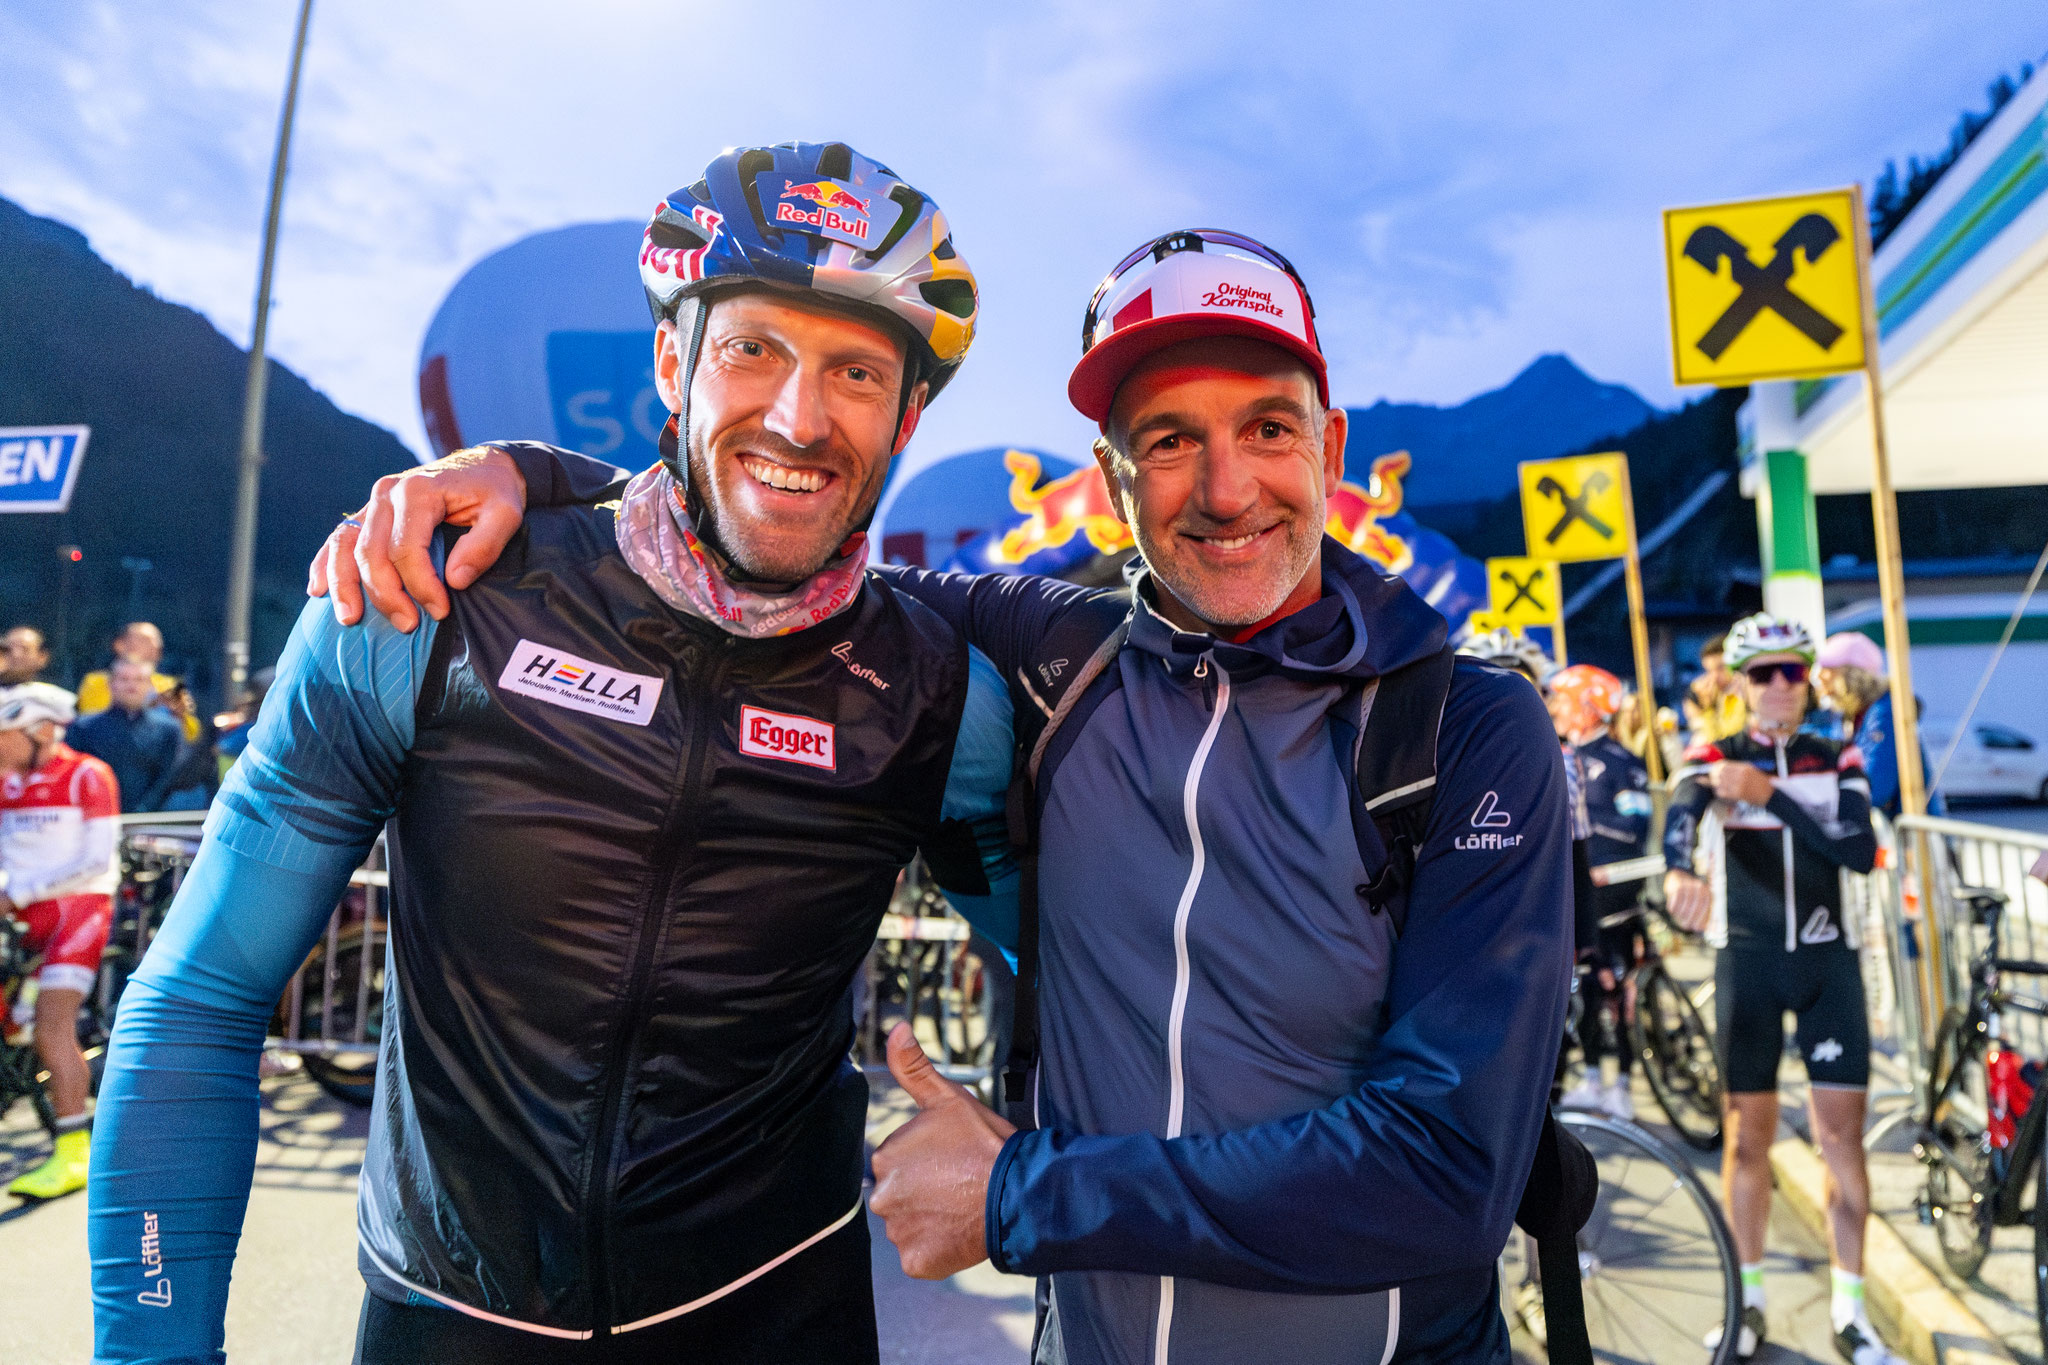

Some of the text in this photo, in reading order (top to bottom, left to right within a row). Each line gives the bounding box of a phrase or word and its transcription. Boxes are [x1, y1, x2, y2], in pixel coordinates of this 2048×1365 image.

[776, 202, 869, 240] Red Bull
[1201, 292, 1284, 318] Kornspitz
[1218, 282, 1272, 302] Original
[523, 654, 642, 706] HELLA
[749, 716, 828, 757] Egger
[1454, 833, 1524, 850] Löffler
[141, 1211, 163, 1278] Löffler
